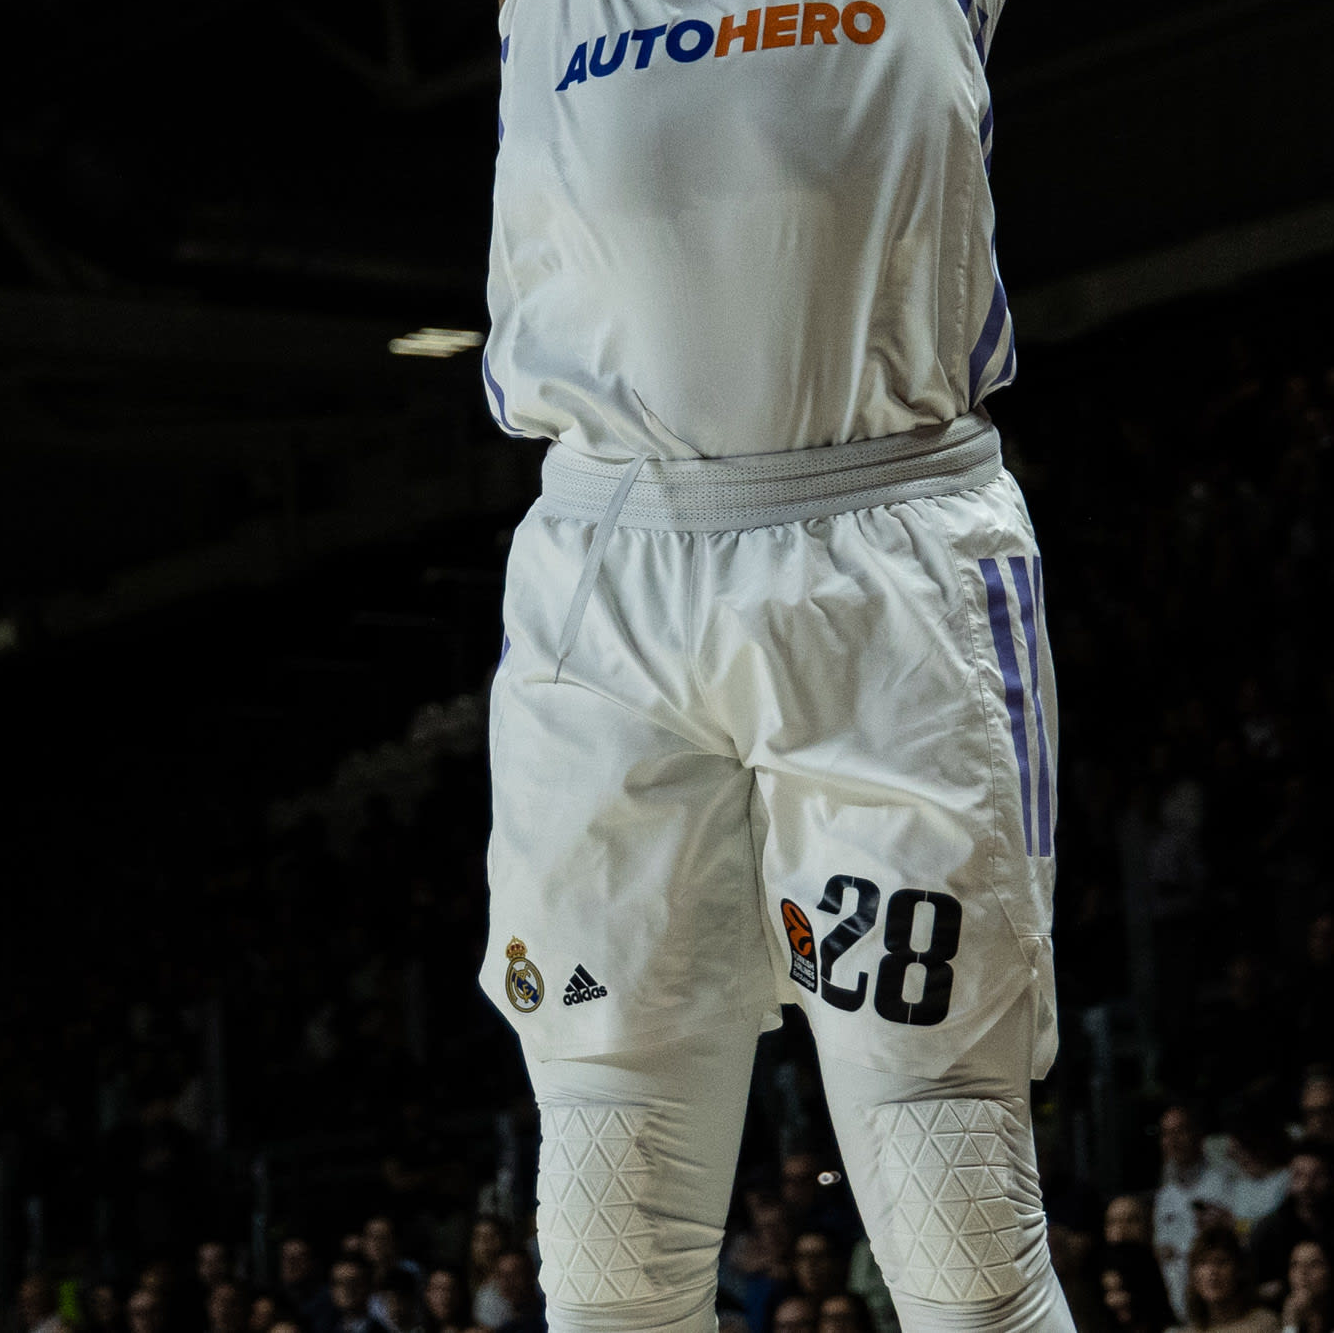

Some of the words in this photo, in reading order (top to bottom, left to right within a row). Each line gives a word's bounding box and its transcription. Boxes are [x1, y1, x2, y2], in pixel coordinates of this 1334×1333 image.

[555, 0, 886, 92] AUTOHERO
[563, 985, 608, 1006] adidas
[817, 874, 962, 1026] 28
